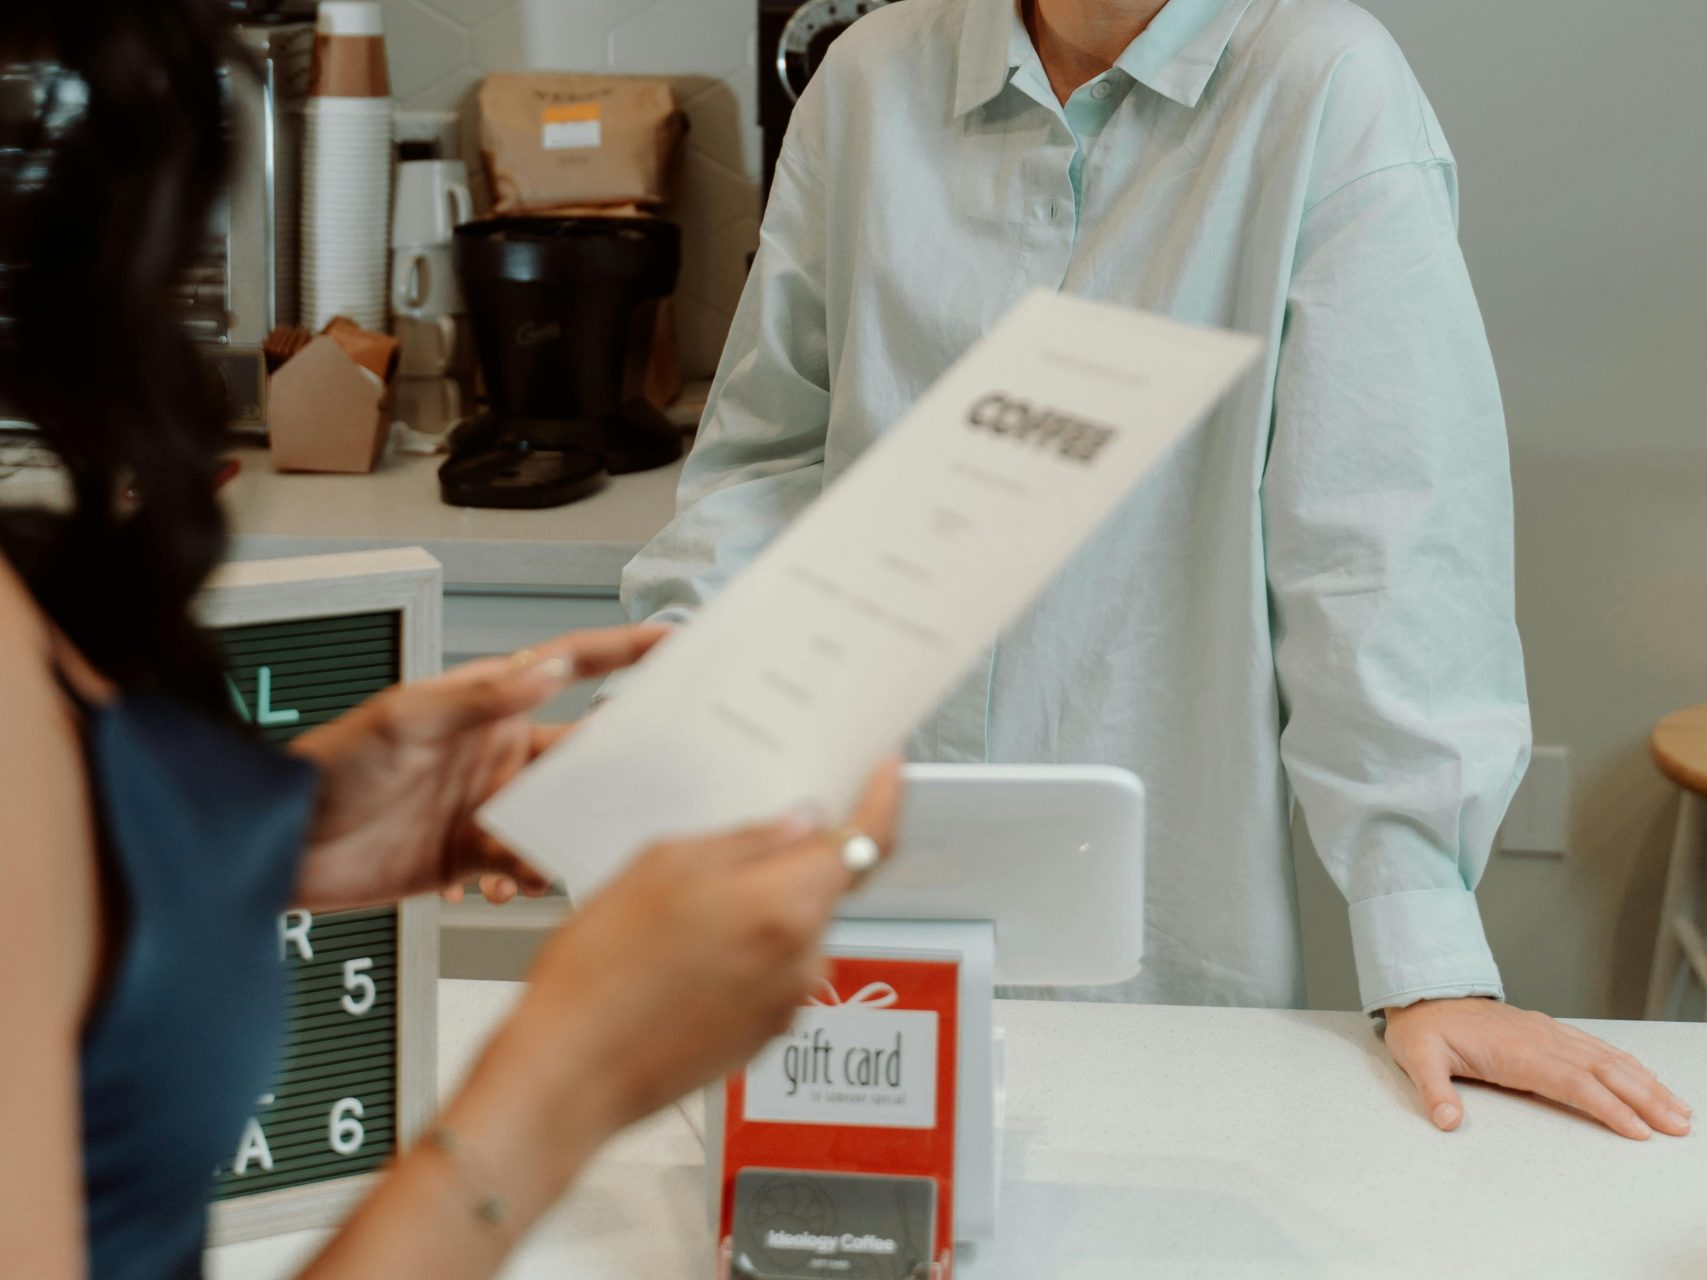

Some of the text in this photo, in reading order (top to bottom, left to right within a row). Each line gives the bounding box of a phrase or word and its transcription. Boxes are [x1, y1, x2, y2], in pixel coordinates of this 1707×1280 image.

[965, 390, 1119, 465] COFFEE
[341, 957, 376, 1016] 5
[784, 1027, 903, 1095] gift card
[329, 1097, 365, 1155] 6
[841, 1233, 896, 1254] Coffee
